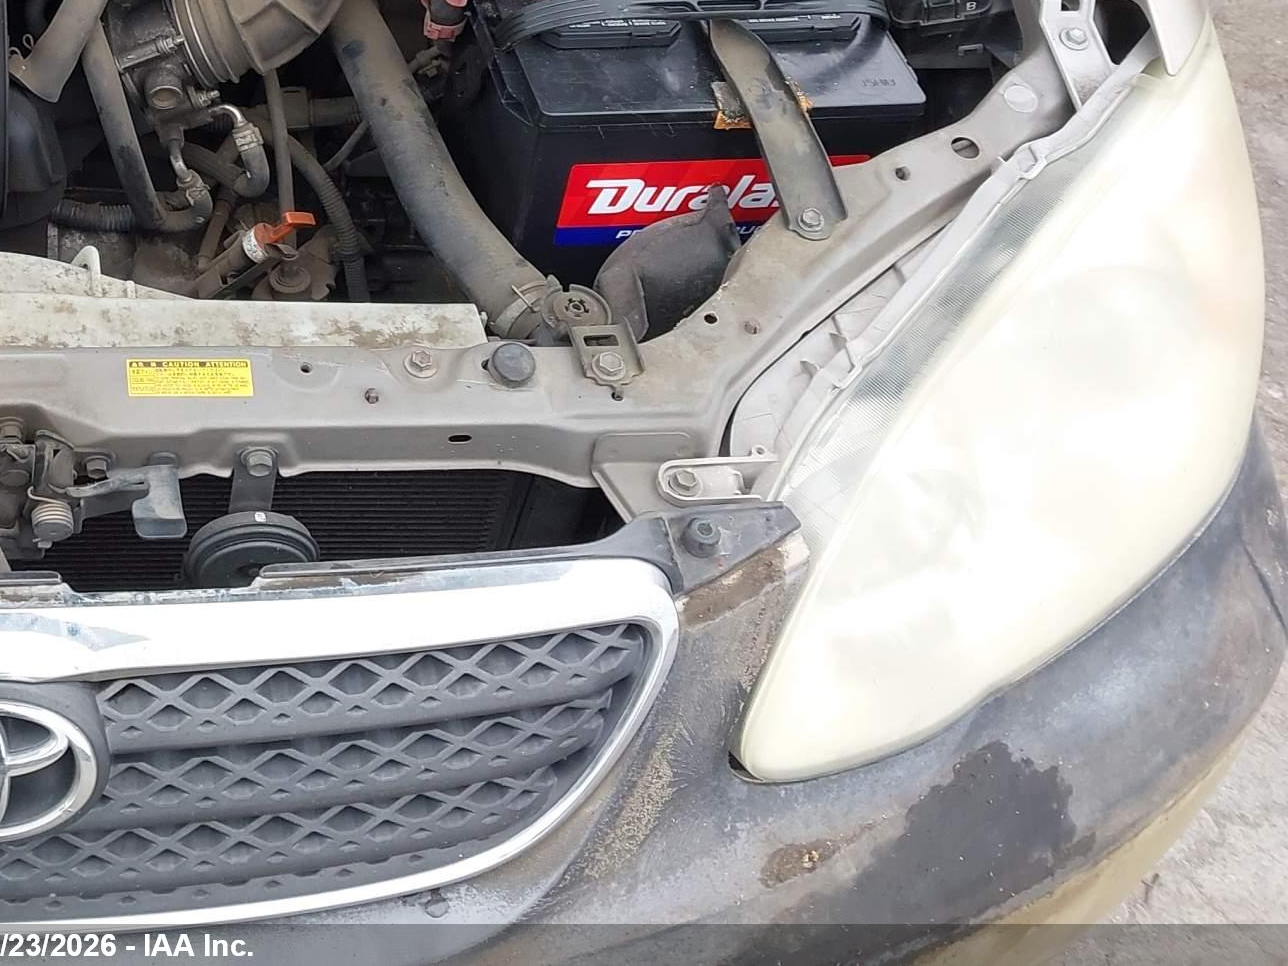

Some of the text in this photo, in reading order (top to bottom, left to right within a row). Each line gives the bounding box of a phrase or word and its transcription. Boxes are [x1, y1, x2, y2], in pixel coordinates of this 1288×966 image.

[965, 1, 977, 11] B
[586, 175, 780, 215] Durala
[162, 360, 200, 368] CAUTION
[205, 360, 248, 368] ATTENTION
